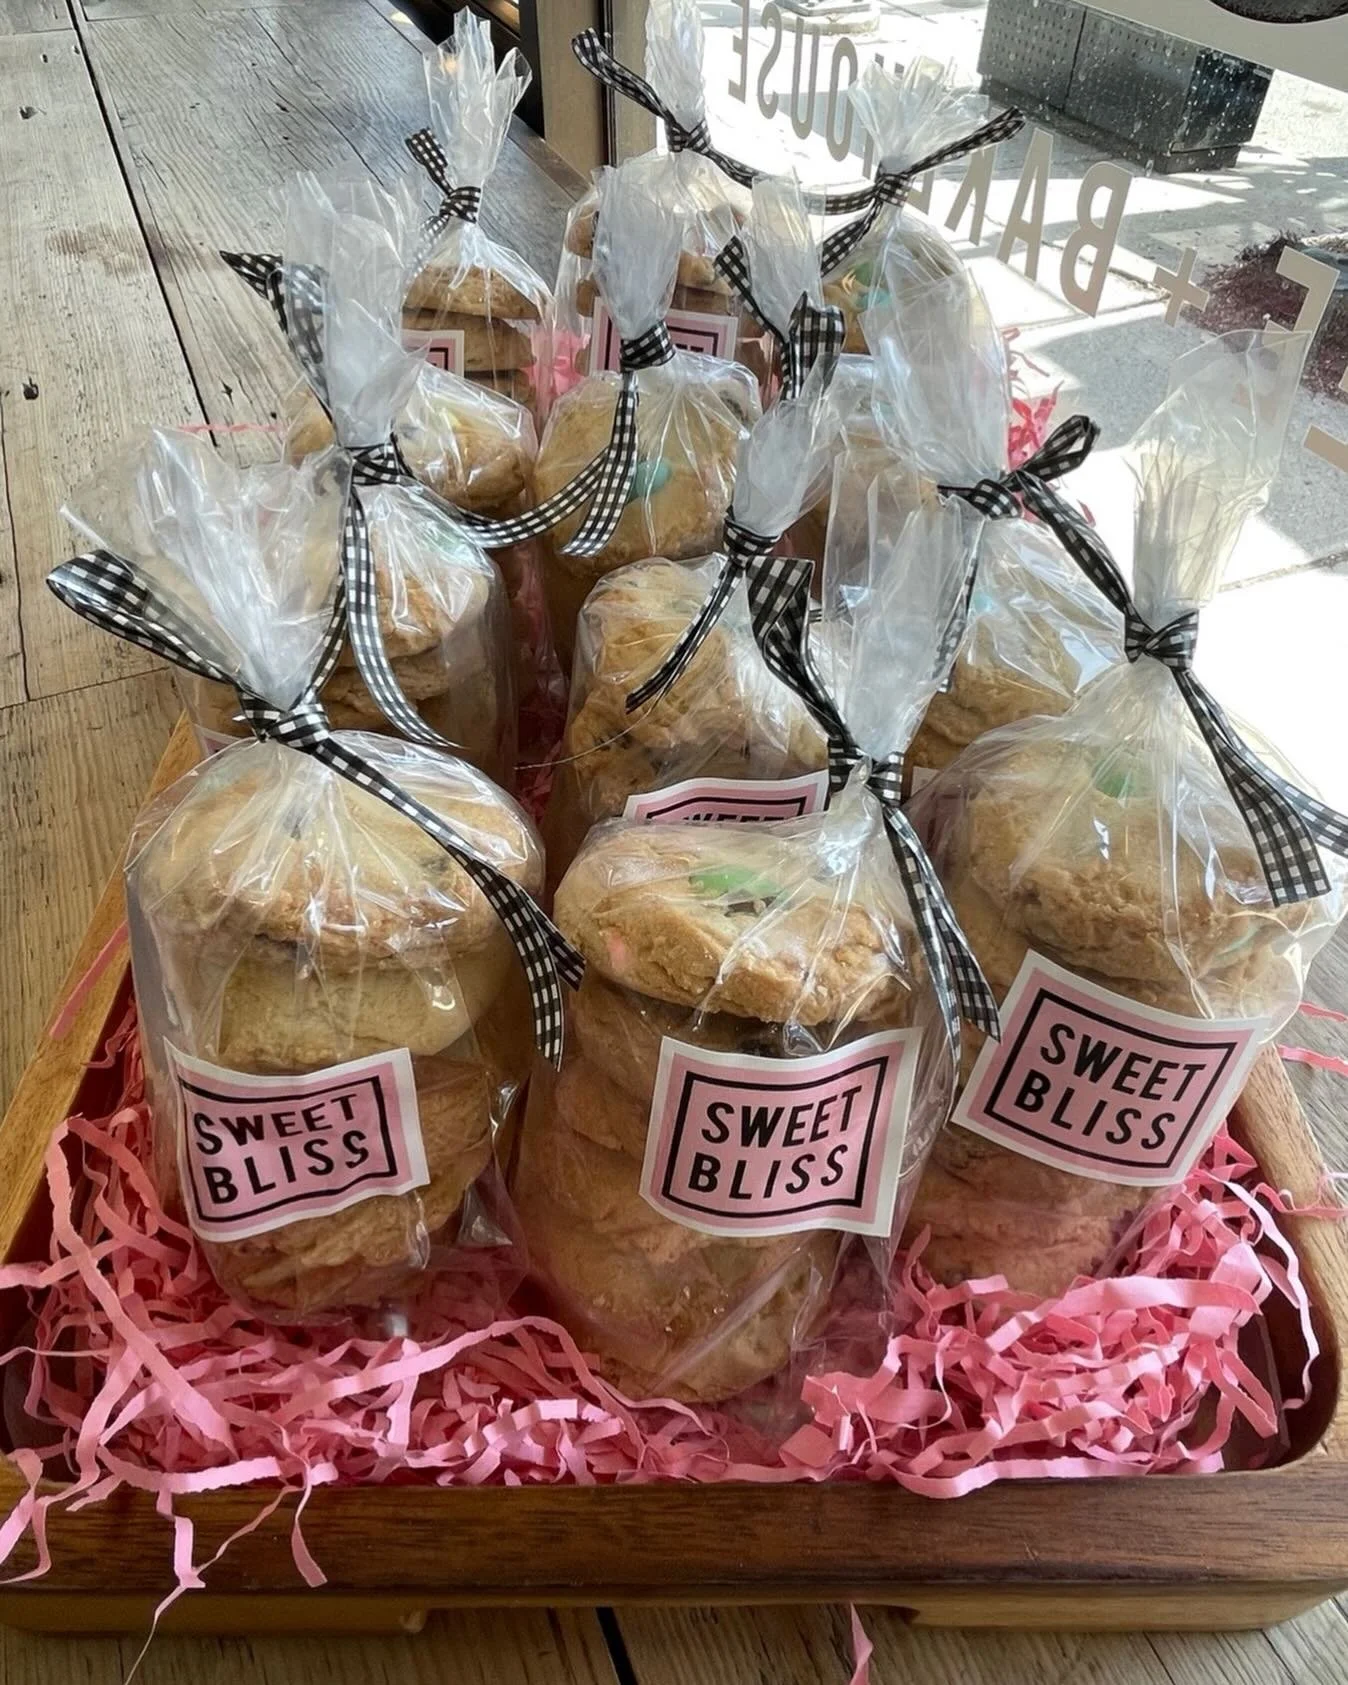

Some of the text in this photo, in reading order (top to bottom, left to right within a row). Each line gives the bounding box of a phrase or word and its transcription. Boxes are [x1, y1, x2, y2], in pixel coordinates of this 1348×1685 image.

[1040, 1023, 1207, 1101] SWEET
[193, 1093, 357, 1155] SWEET
[701, 1085, 862, 1148] SWEET
[1014, 1069, 1176, 1150] BLISS
[203, 1130, 369, 1205] BLISS
[688, 1144, 848, 1200] BLISS
